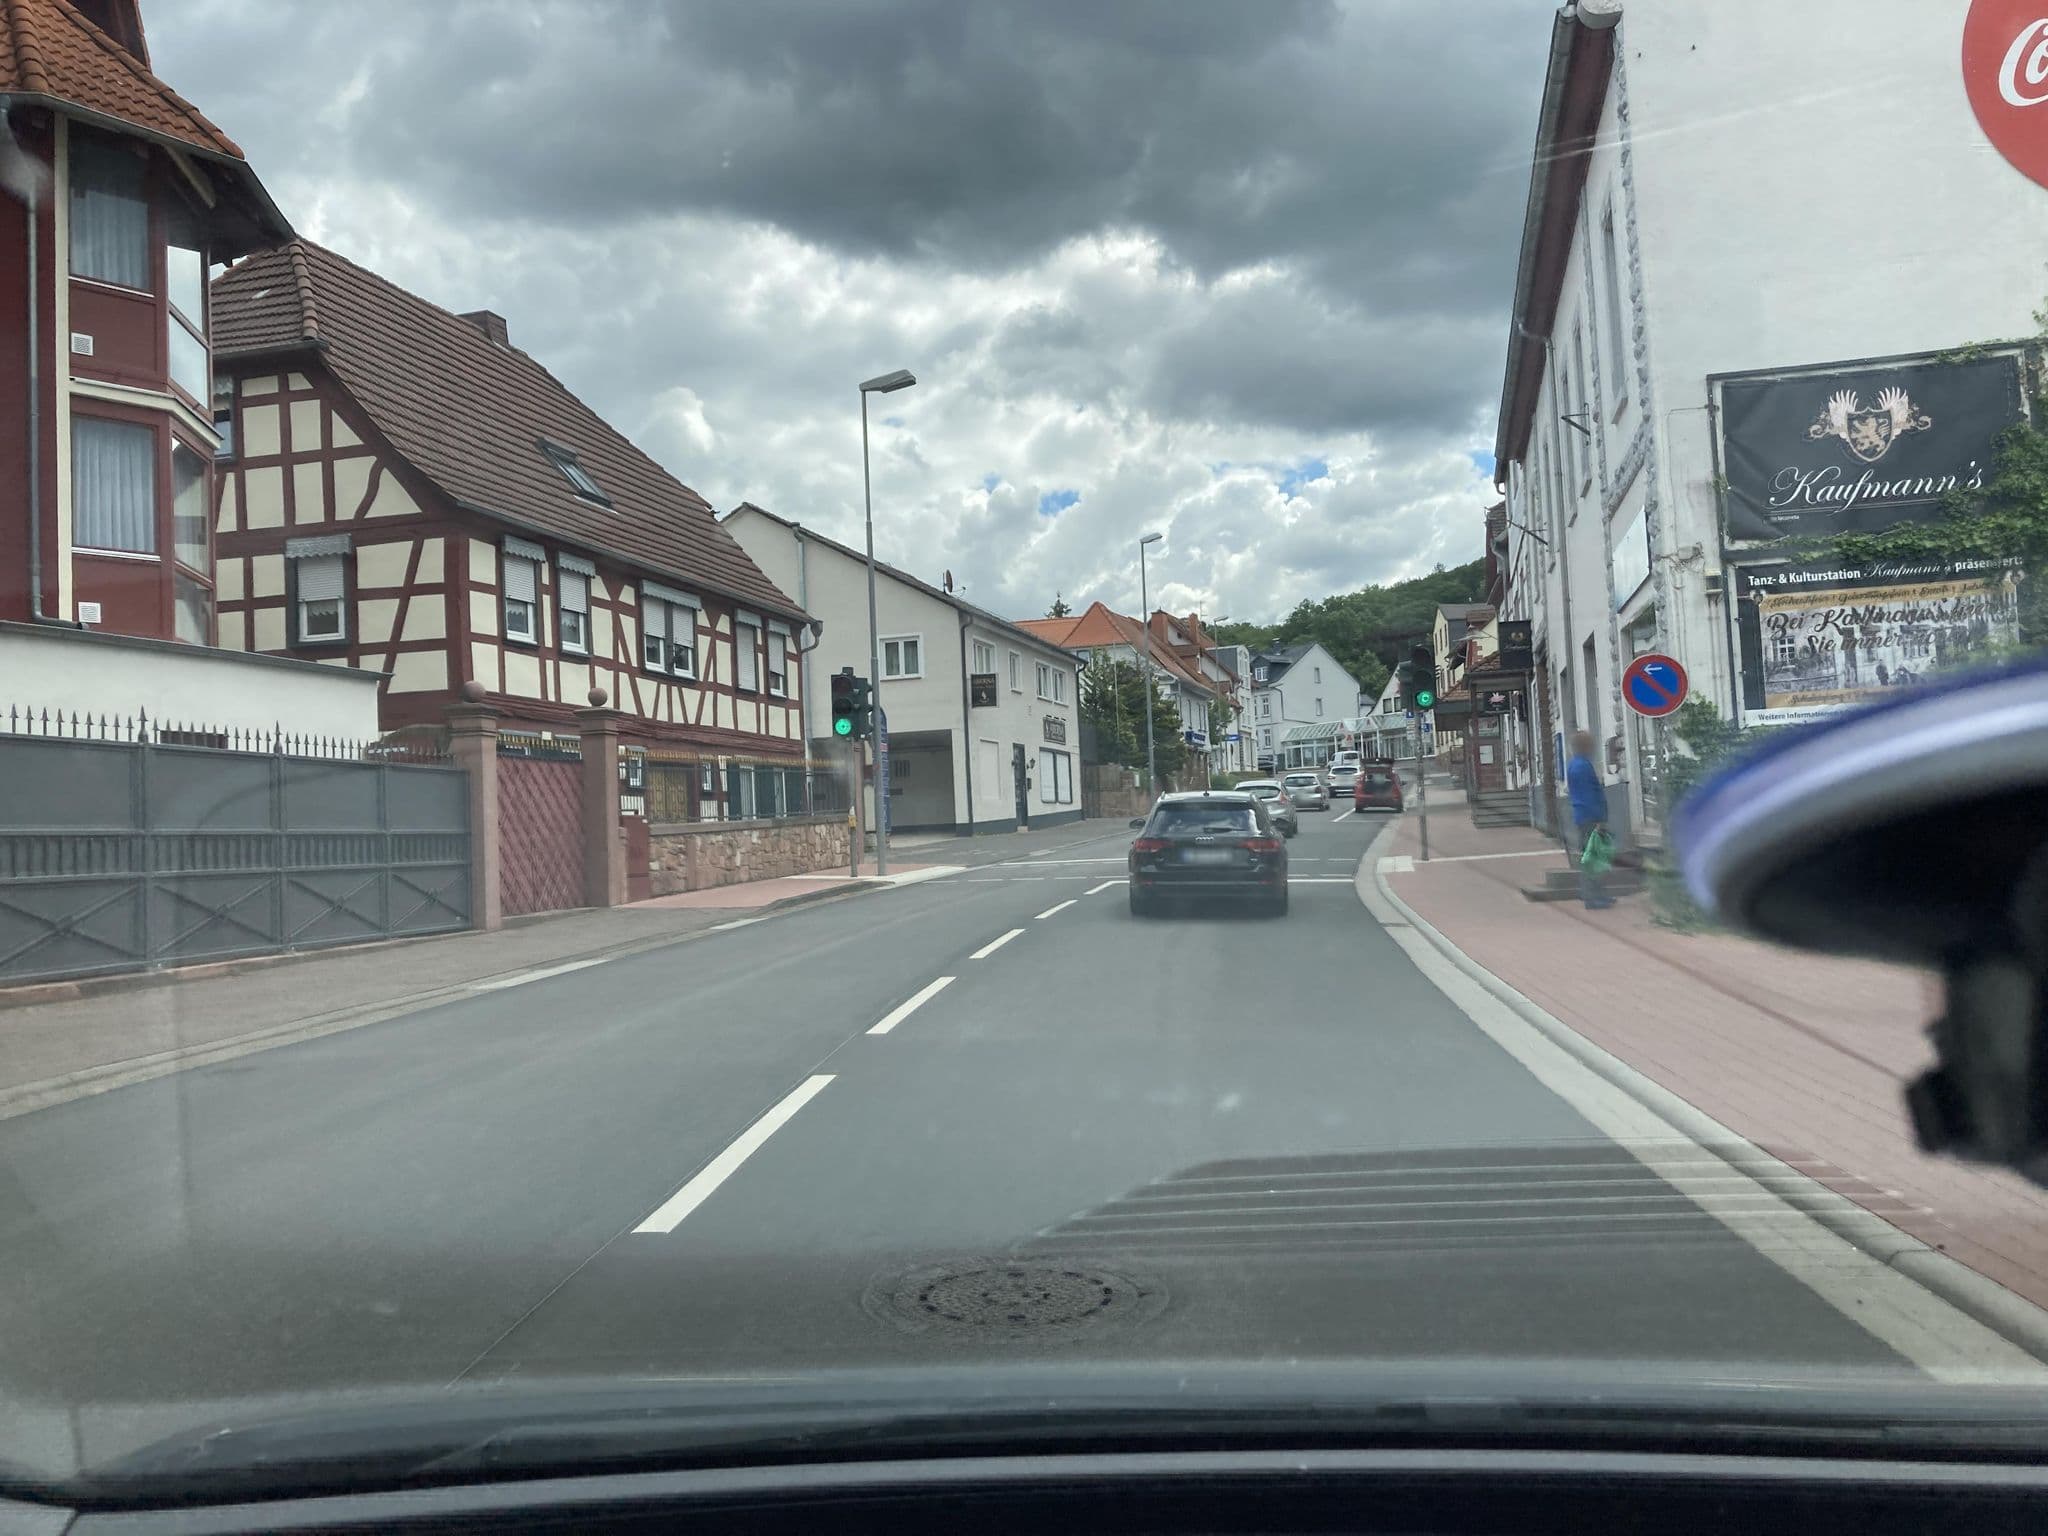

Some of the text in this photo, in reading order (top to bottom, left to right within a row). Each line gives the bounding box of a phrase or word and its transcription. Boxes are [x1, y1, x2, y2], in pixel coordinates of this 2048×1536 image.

[1769, 461, 1982, 516] Kaufmann's
[1748, 575, 1776, 586] Tanz-
[1778, 573, 1788, 584] &
[1789, 569, 1861, 583] Kulturstation
[1954, 555, 2023, 573] präsenert:
[1758, 711, 1785, 721] Weitere
